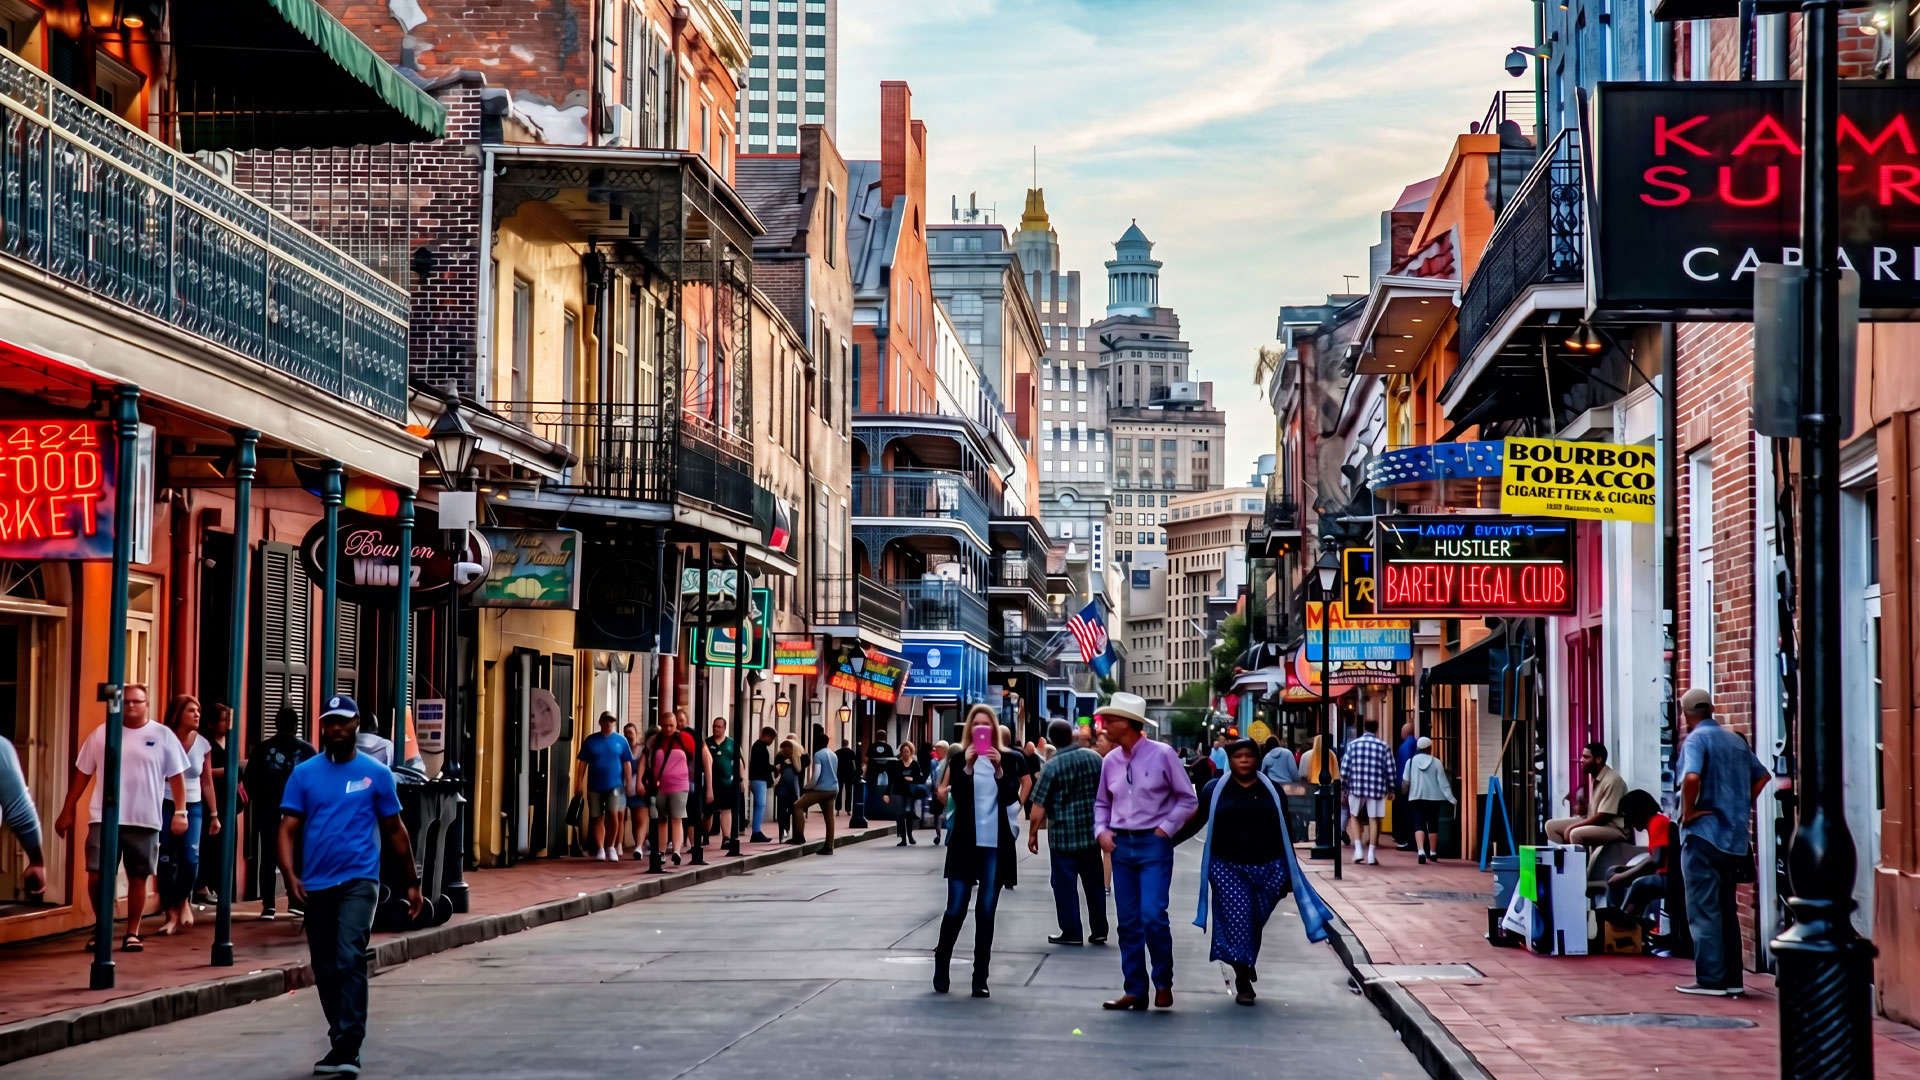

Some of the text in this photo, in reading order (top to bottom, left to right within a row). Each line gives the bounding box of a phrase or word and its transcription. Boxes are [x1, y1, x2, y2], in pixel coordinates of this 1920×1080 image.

[1639, 165, 1920, 207] SUR
[1509, 443, 1655, 469] BOURBON
[1509, 464, 1655, 490] TOBACCO
[1593, 490, 1606, 502] &
[1607, 491, 1655, 506] CIGARS
[344, 529, 436, 559] Bouron
[1434, 539, 1512, 558] HUSTLER
[1386, 565, 1567, 605] BARELY LEGAL CLUB
